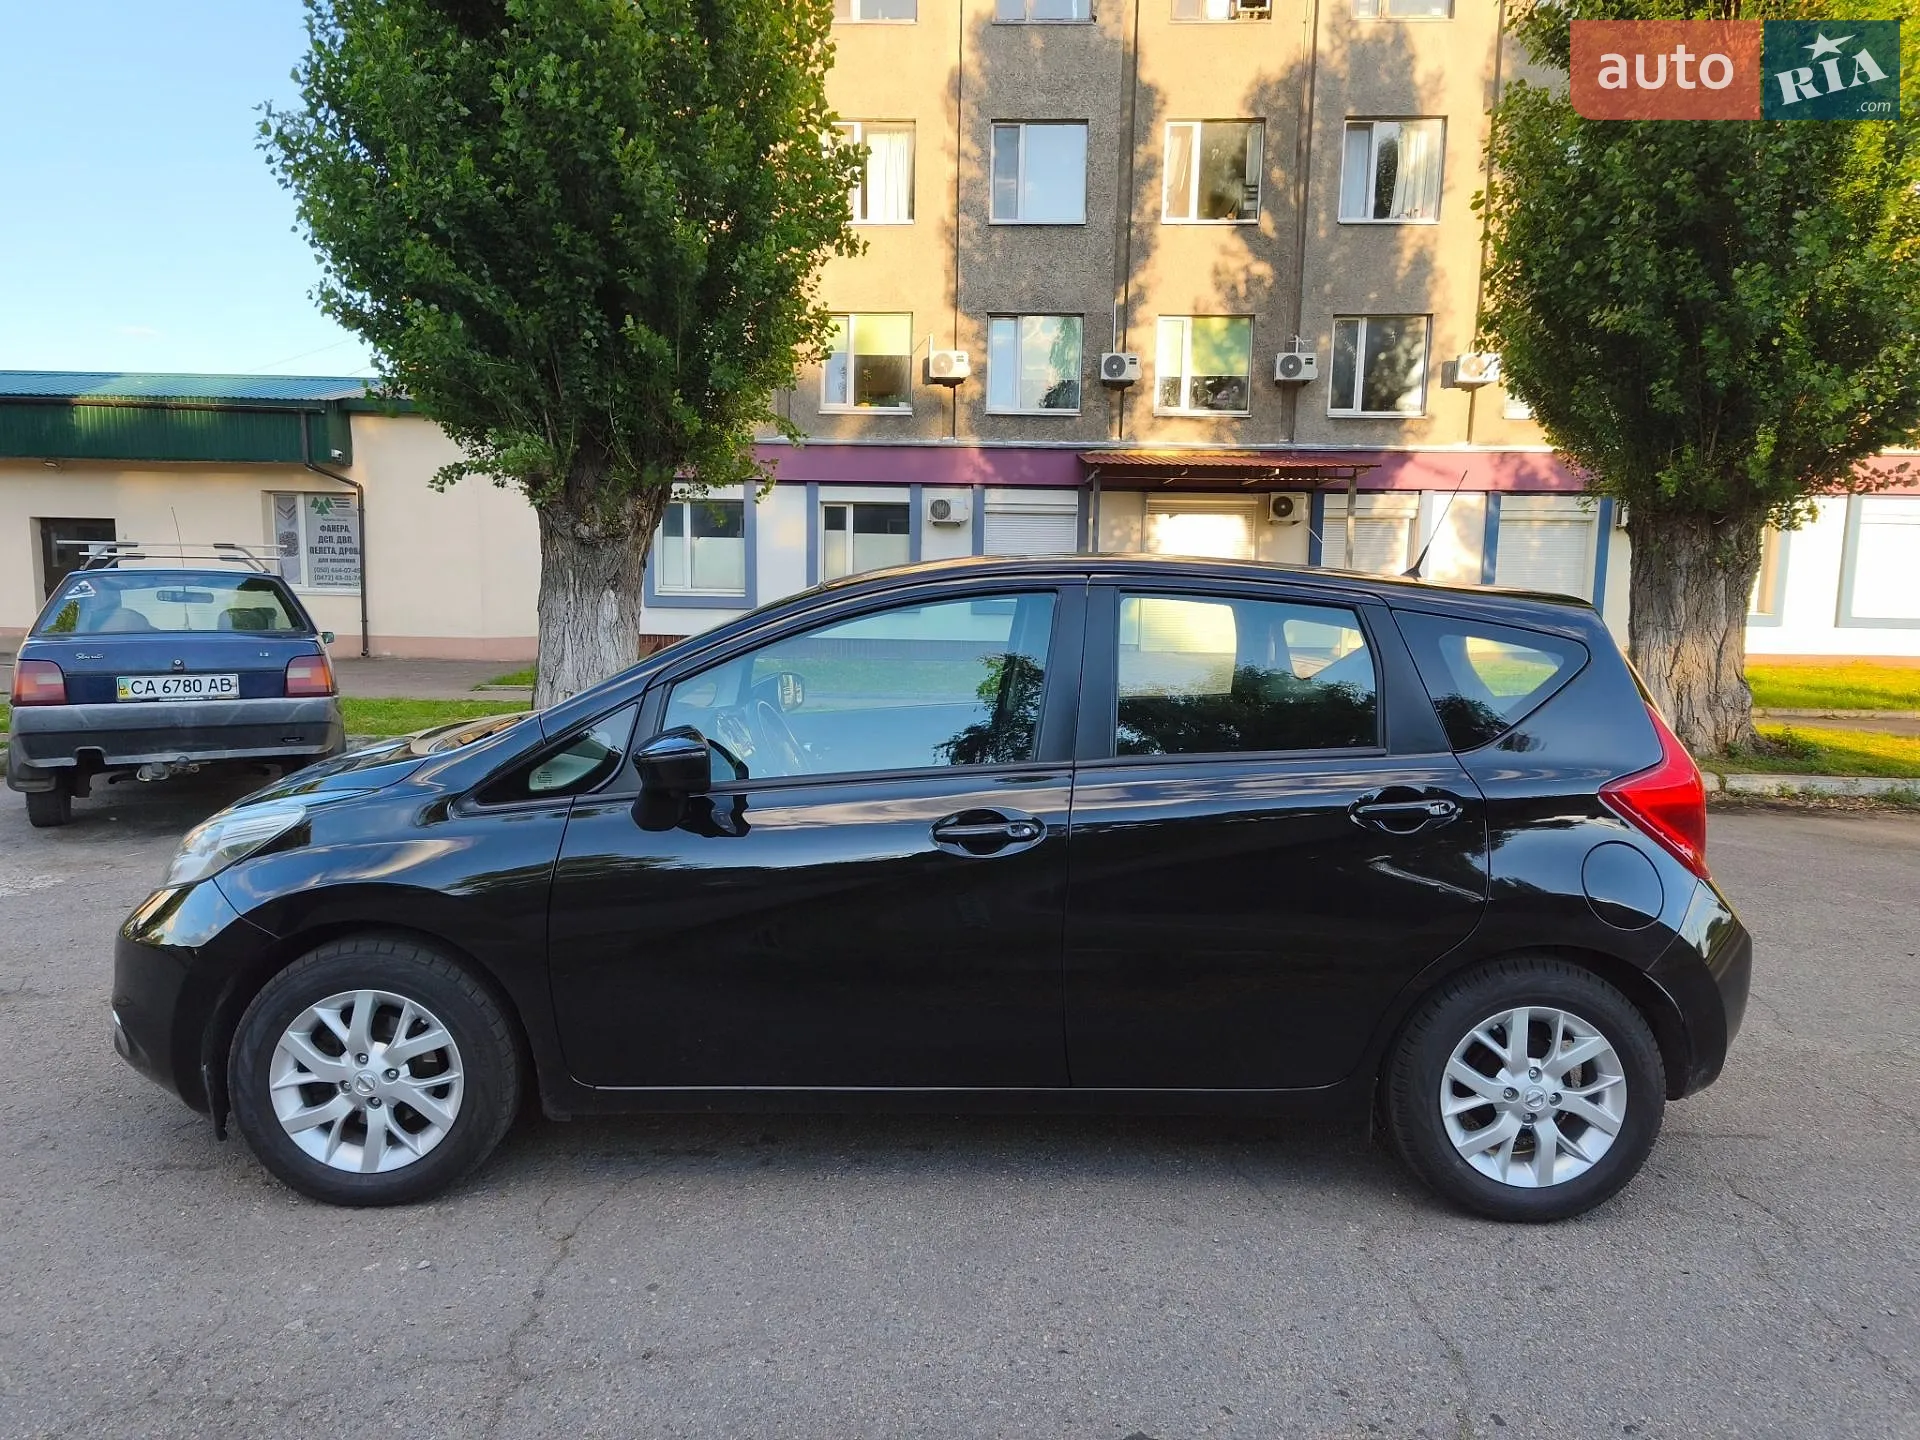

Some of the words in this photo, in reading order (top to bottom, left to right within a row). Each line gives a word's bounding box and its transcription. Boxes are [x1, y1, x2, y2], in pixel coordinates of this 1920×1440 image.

[131, 680, 157, 695] CA
[162, 679, 202, 693] 6780
[207, 678, 233, 692] AB
